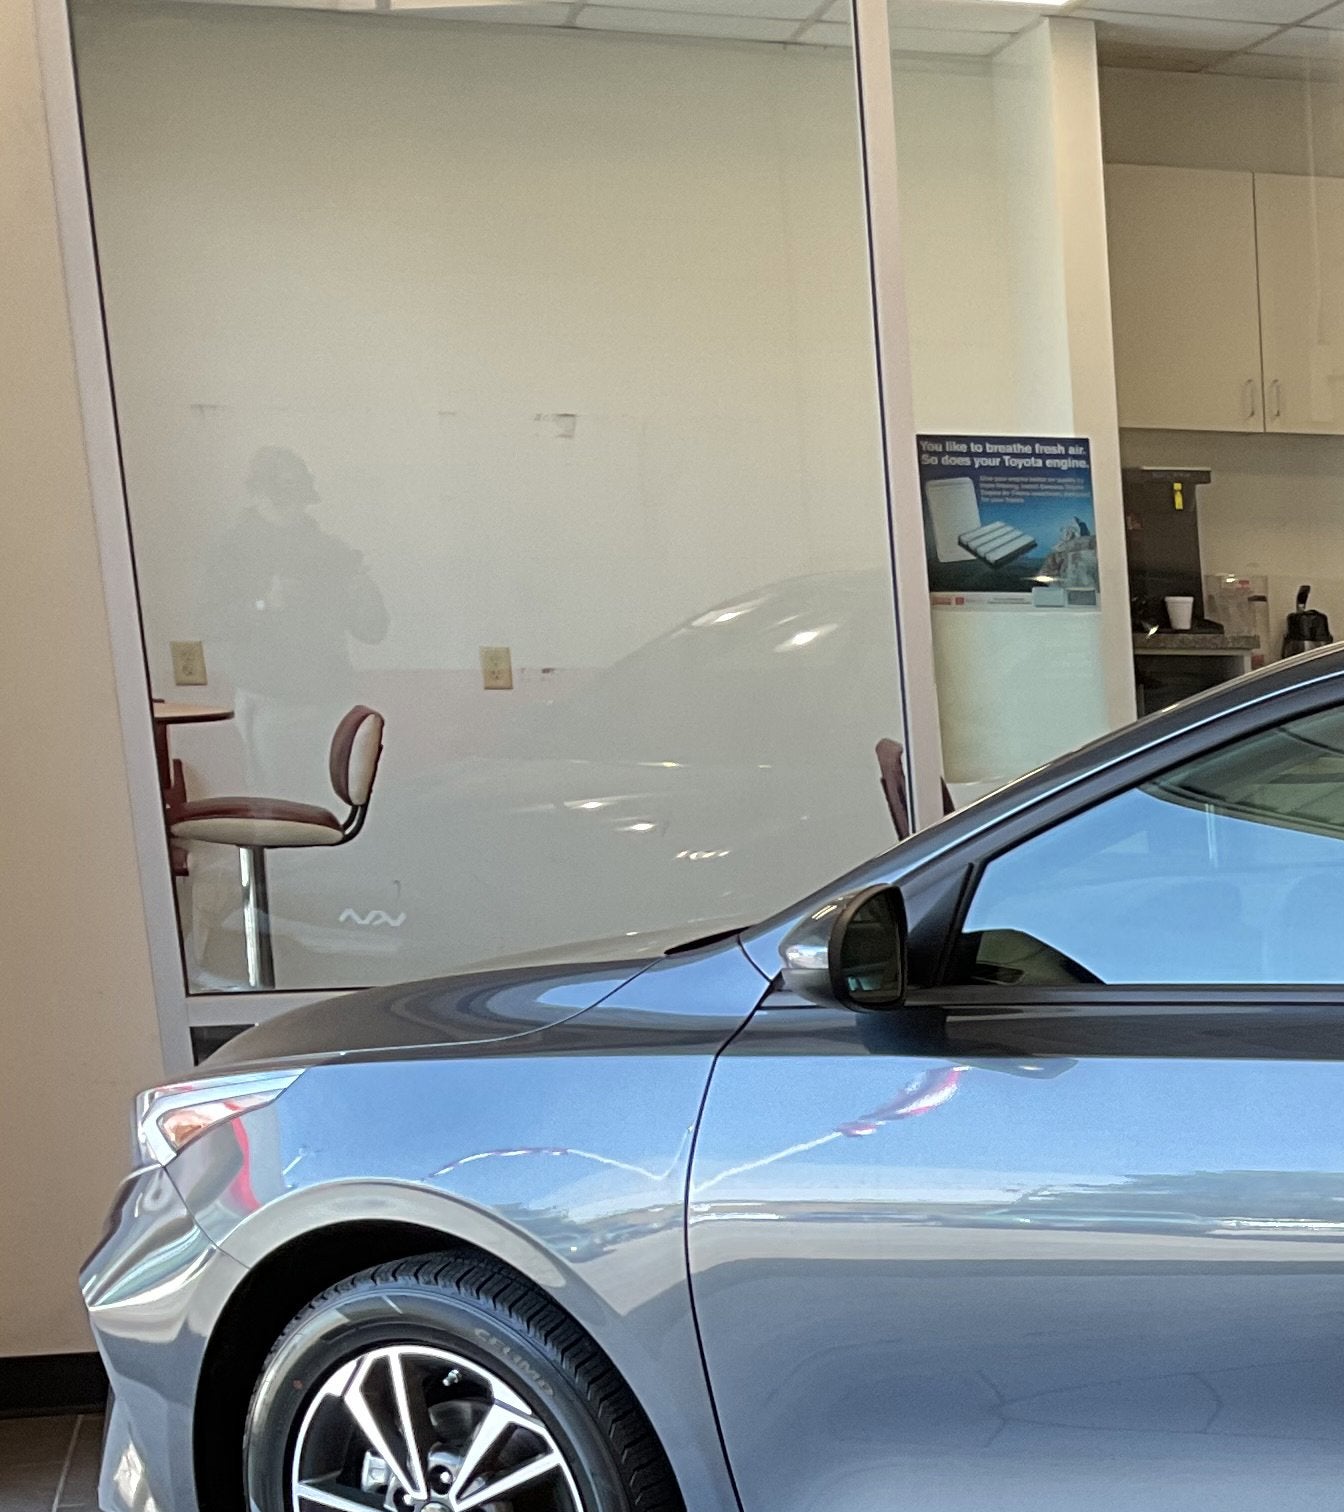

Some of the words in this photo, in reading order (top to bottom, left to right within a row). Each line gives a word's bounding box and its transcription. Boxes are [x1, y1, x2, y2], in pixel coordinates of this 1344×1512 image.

[920, 440, 943, 452] You
[945, 440, 967, 452] like
[970, 442, 984, 453] to
[985, 443, 1033, 455] breathe
[1034, 443, 1066, 455] fresh
[920, 454, 939, 466] So
[941, 454, 971, 467] does
[973, 455, 1002, 469] your
[1002, 455, 1043, 470] Toyota
[1045, 458, 1090, 471] engine.
